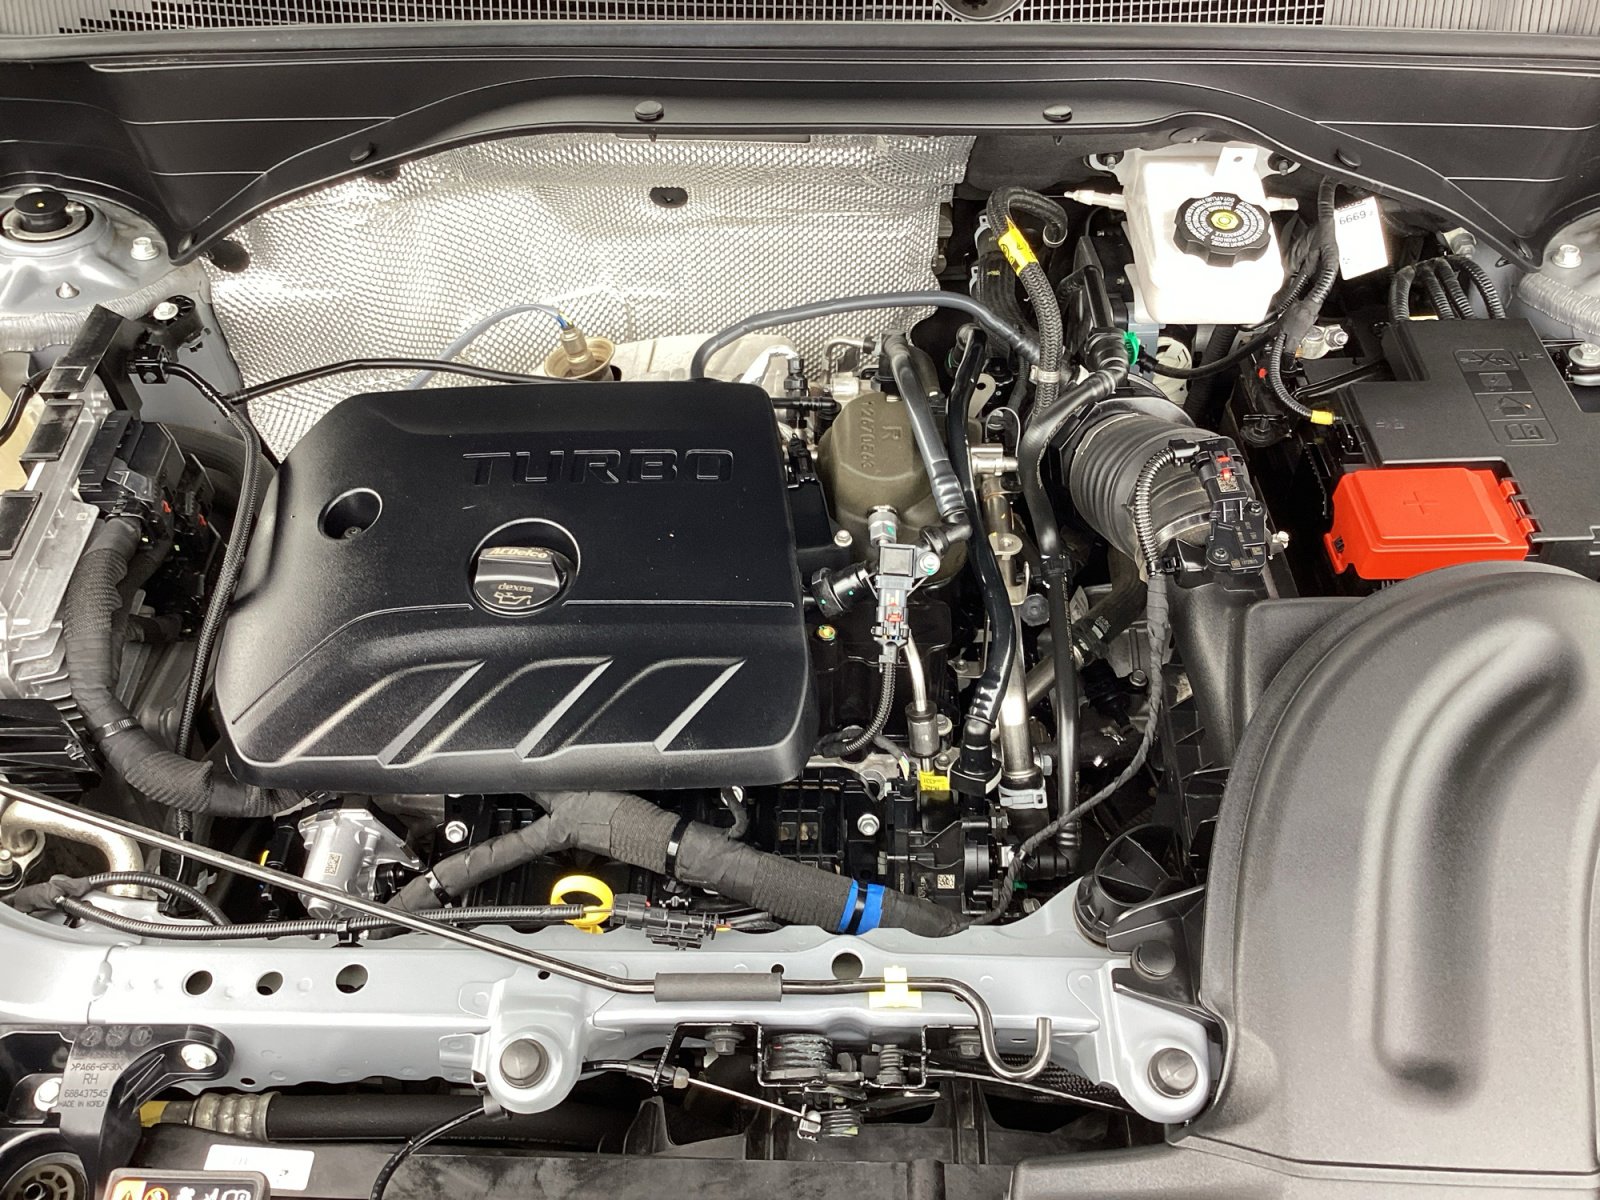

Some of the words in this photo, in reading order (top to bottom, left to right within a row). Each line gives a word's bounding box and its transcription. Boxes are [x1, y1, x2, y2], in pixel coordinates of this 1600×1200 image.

[462, 448, 734, 486] TURBO
[490, 548, 549, 559] ACDelco
[497, 582, 535, 593] dexos
[82, 1073, 99, 1085] RH
[77, 1100, 84, 1108] IN
[86, 1099, 105, 1108] KOREA
